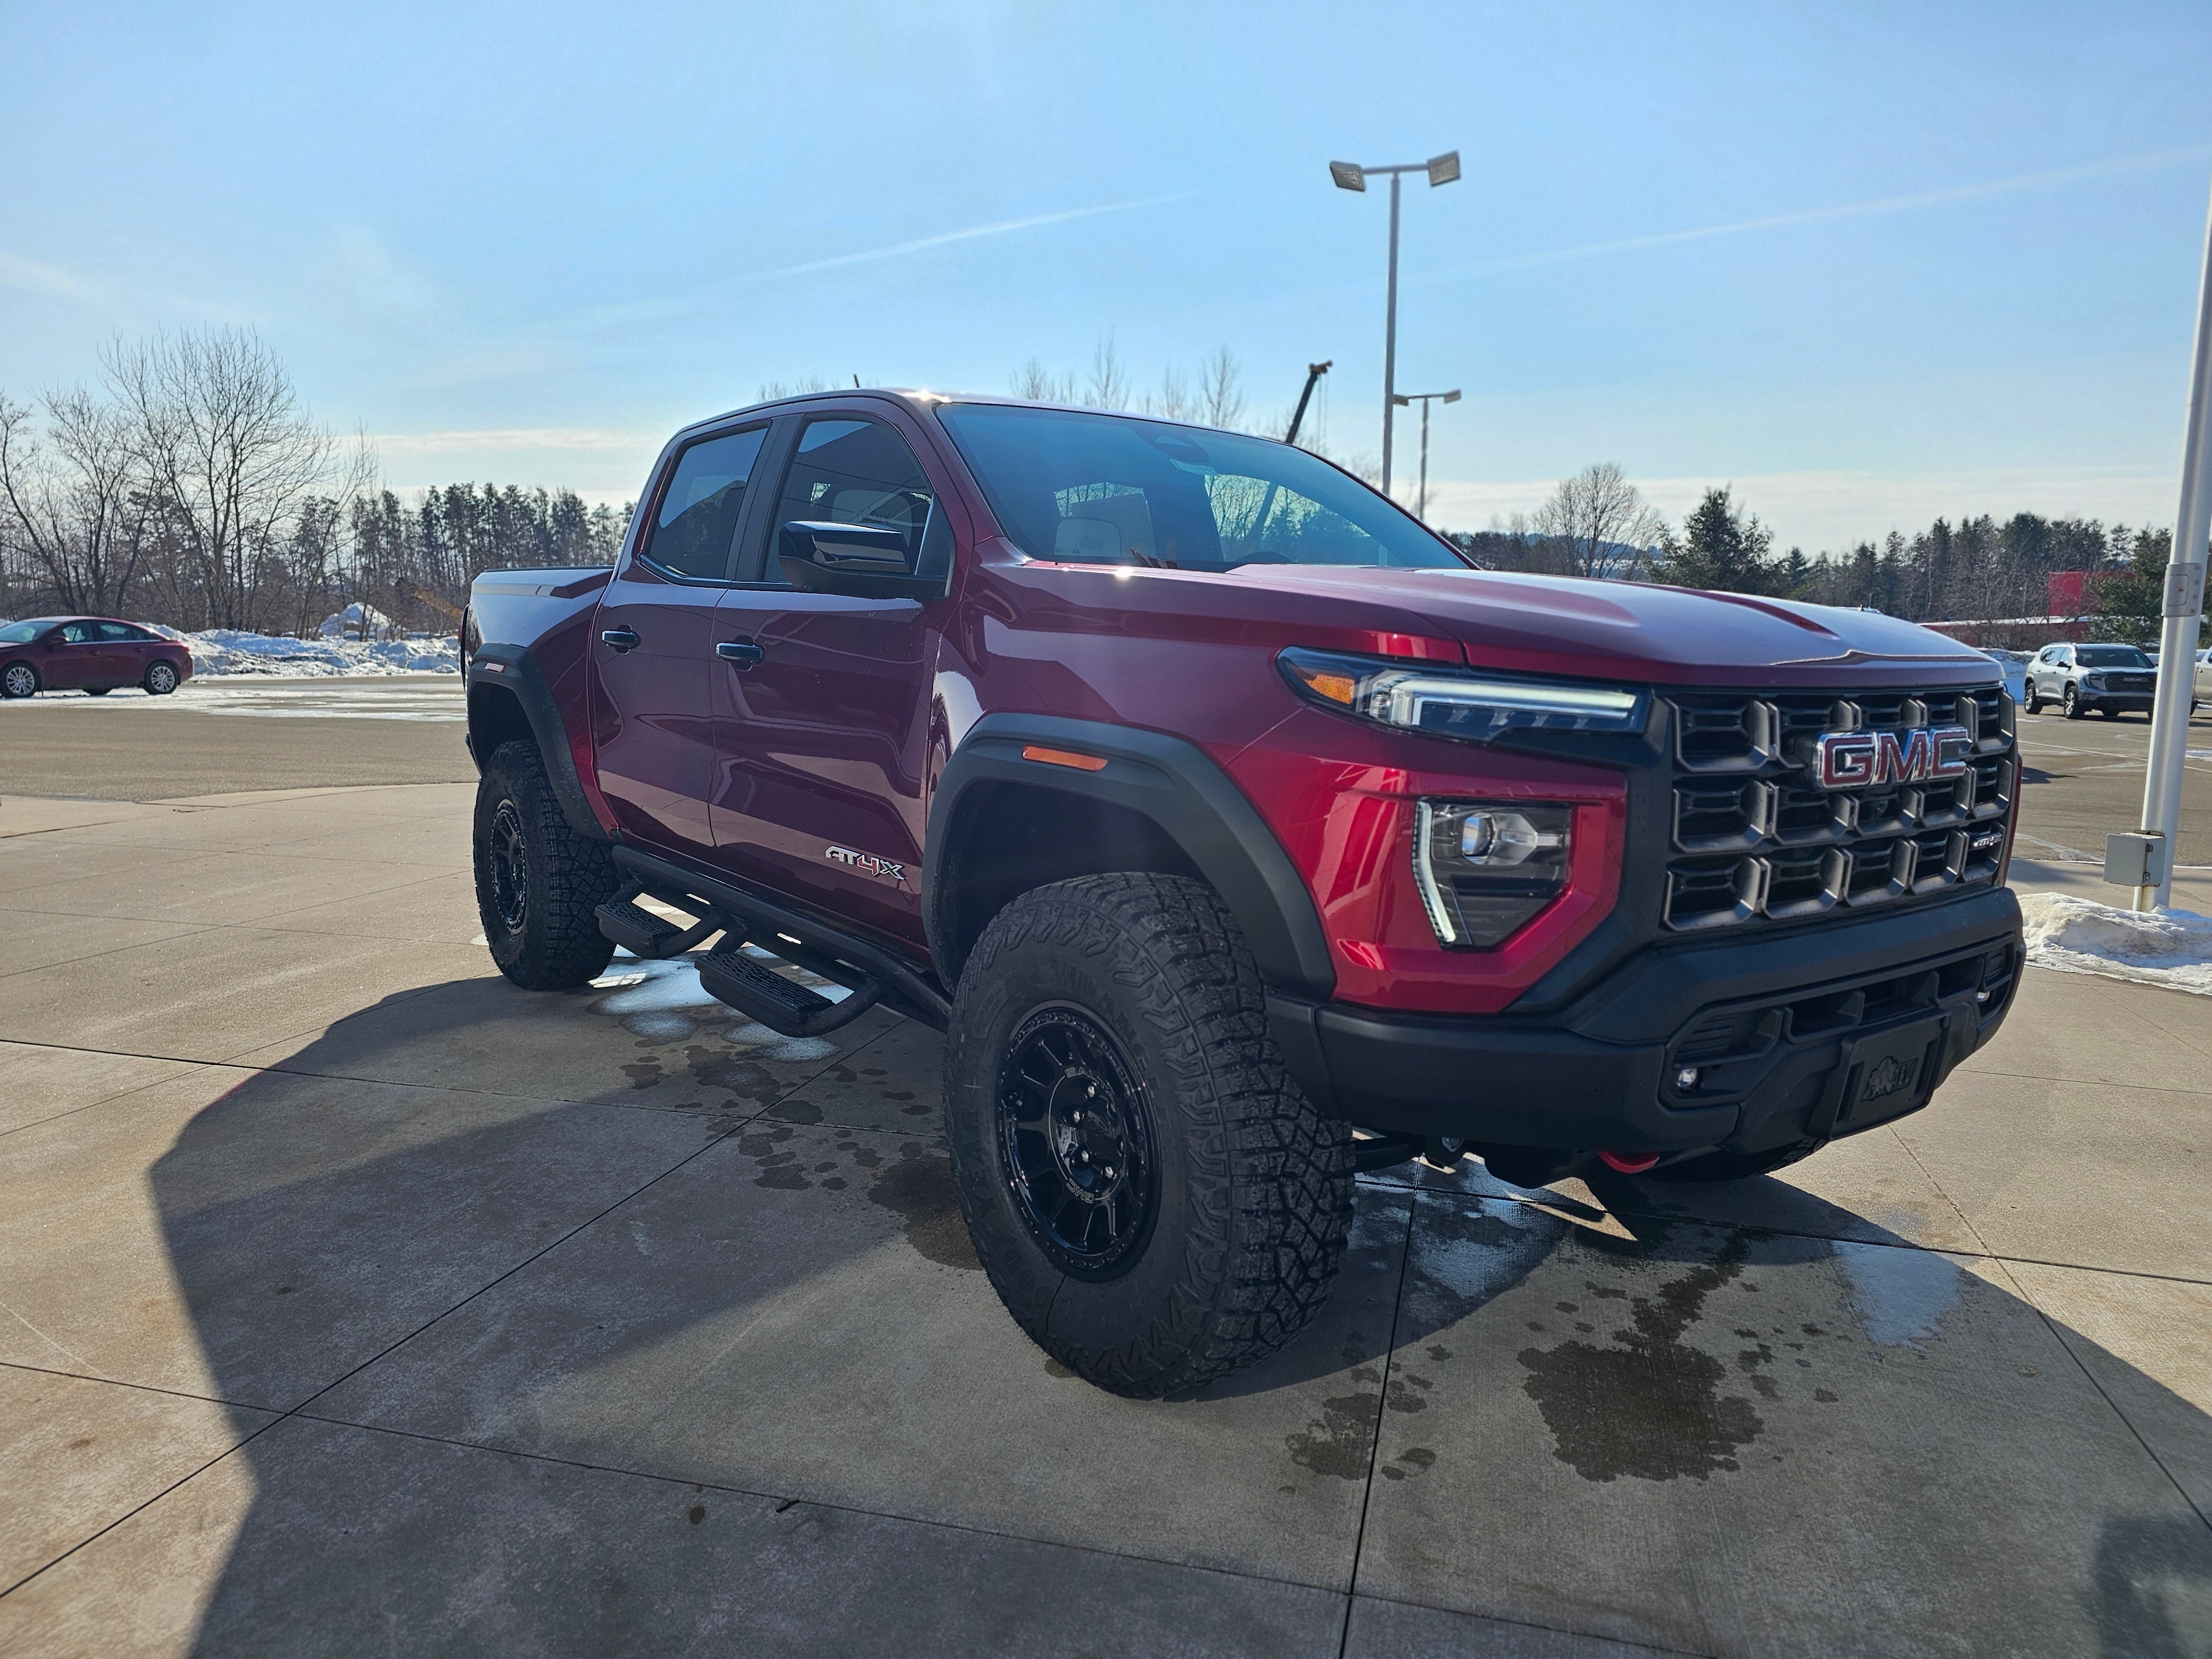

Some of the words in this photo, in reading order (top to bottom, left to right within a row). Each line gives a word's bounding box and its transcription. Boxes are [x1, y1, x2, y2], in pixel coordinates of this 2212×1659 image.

[1817, 728, 1969, 788] GMC
[825, 846, 908, 880] AT4X
[1066, 1179, 1095, 1205] GMC
